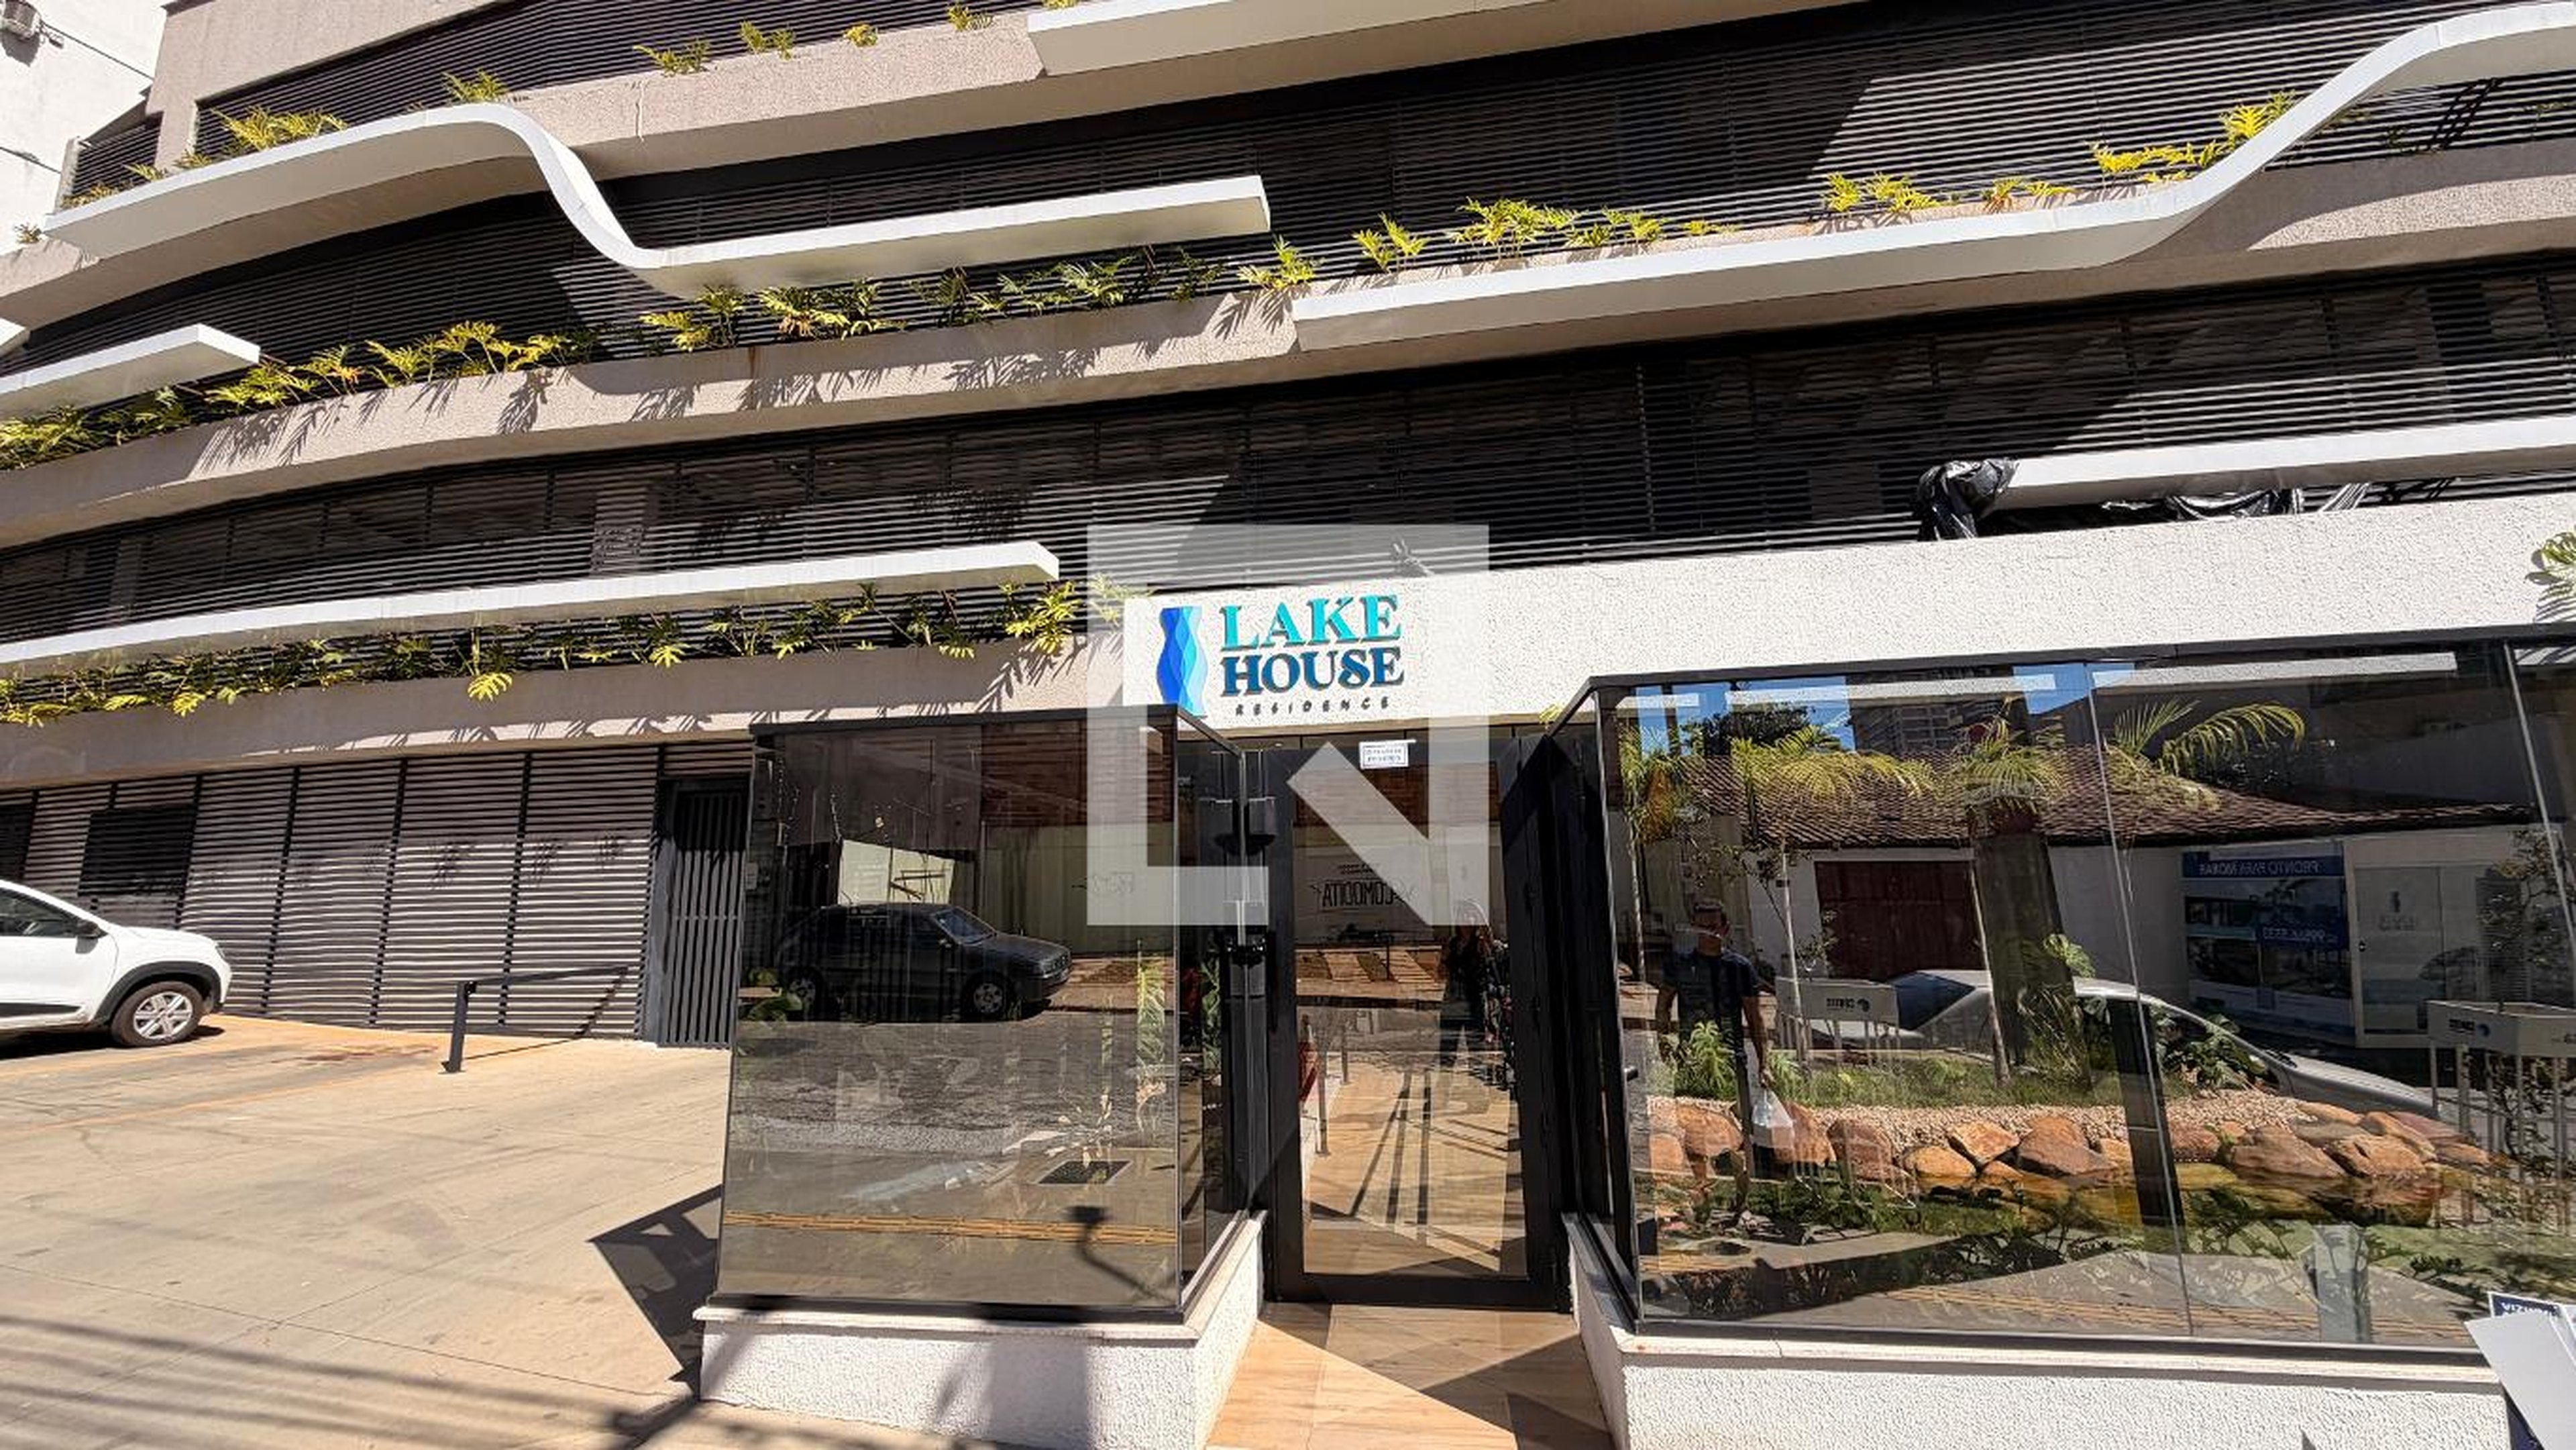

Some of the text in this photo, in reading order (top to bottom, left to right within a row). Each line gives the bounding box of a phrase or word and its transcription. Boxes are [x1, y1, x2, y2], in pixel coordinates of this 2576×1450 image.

[1220, 594, 1402, 651] LAKE
[1220, 647, 1404, 697] HOUSE
[1236, 696, 1389, 716] RESIDENCE
